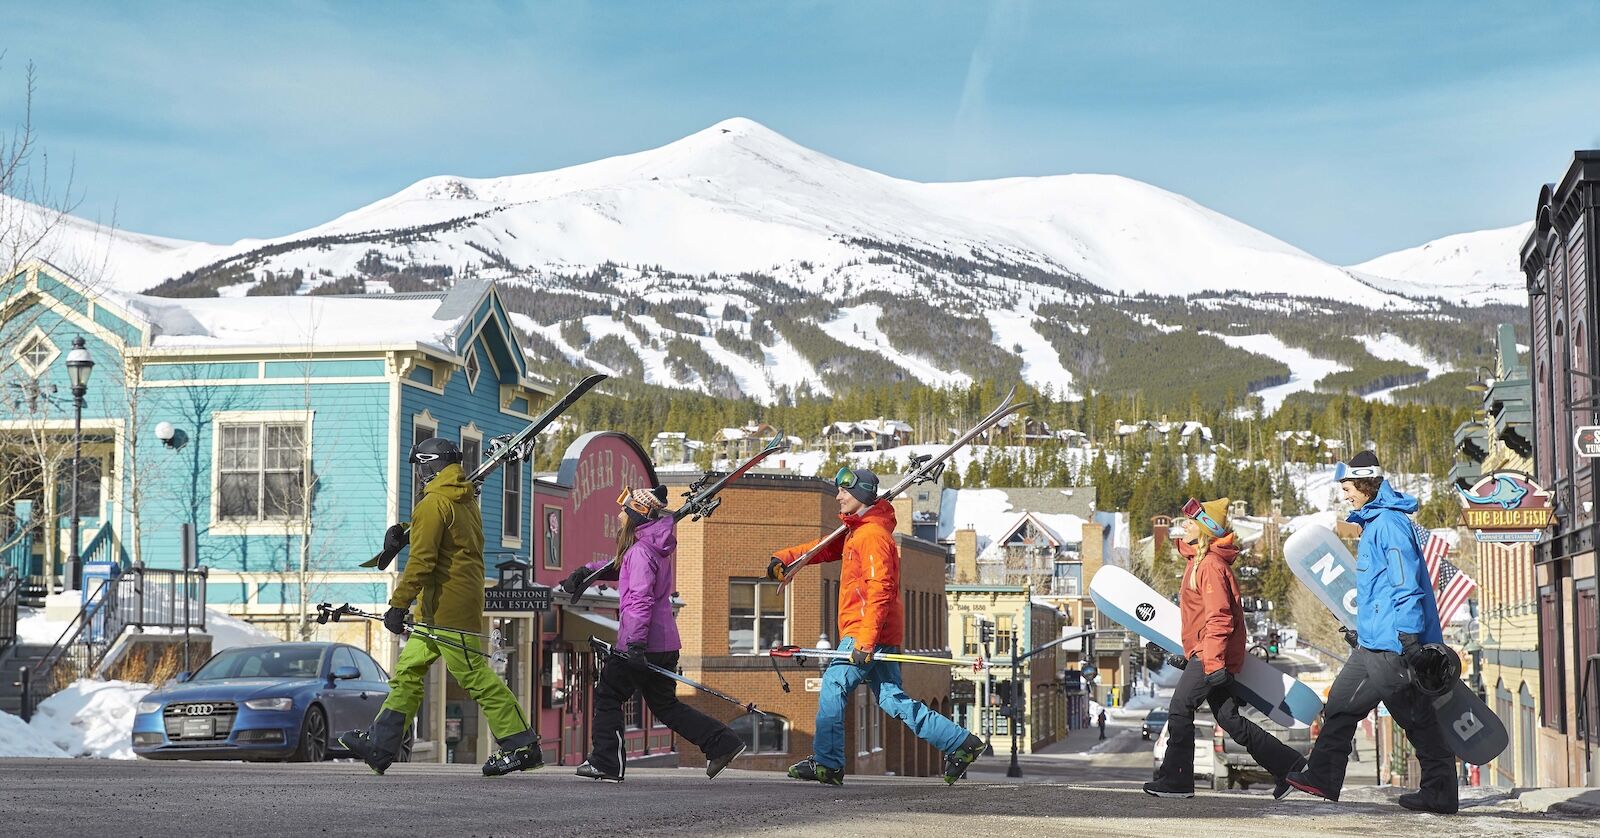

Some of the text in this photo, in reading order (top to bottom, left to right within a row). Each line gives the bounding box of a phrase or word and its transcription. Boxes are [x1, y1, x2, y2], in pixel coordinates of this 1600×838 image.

[572, 450, 614, 514] BRIAR
[1468, 511, 1490, 526] THE
[1493, 511, 1520, 526] BLUE
[485, 590, 548, 598] ORNERSTONE
[485, 600, 548, 609] EAL ESTATE
